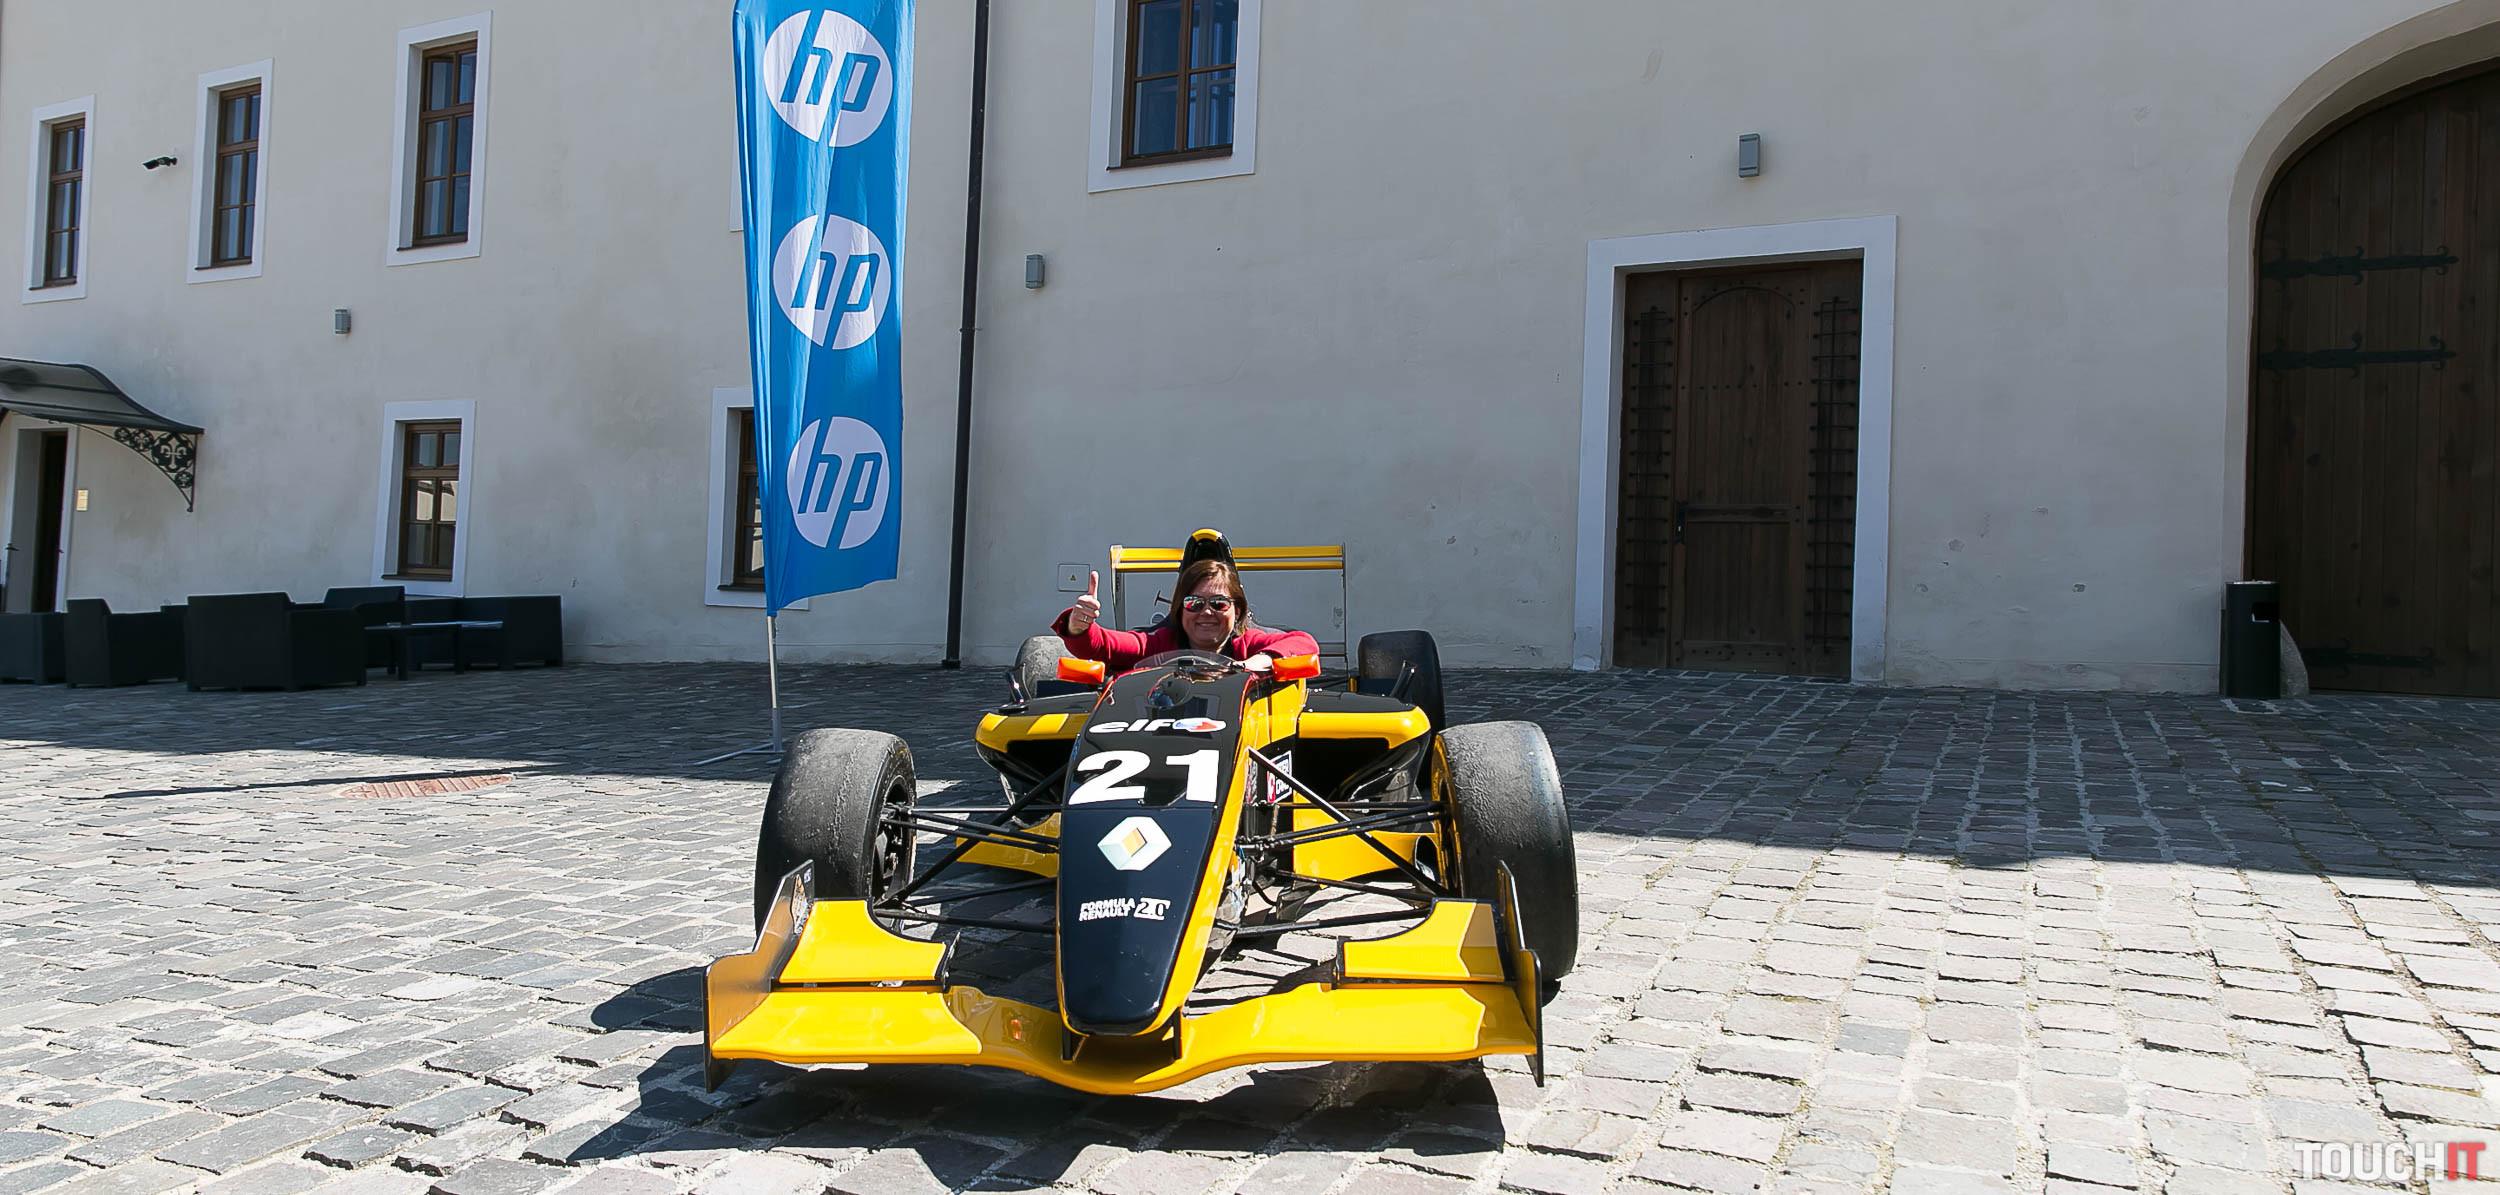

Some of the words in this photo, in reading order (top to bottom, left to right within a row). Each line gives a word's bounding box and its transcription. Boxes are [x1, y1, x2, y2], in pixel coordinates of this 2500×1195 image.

[780, 10, 882, 147] hp
[790, 214, 879, 350] hp
[798, 416, 883, 550] hp
[1068, 749, 1220, 805] 21
[1079, 906, 1131, 921] RENAULT
[1136, 900, 1168, 919] 2.0
[1080, 898, 1136, 911] FORMULA
